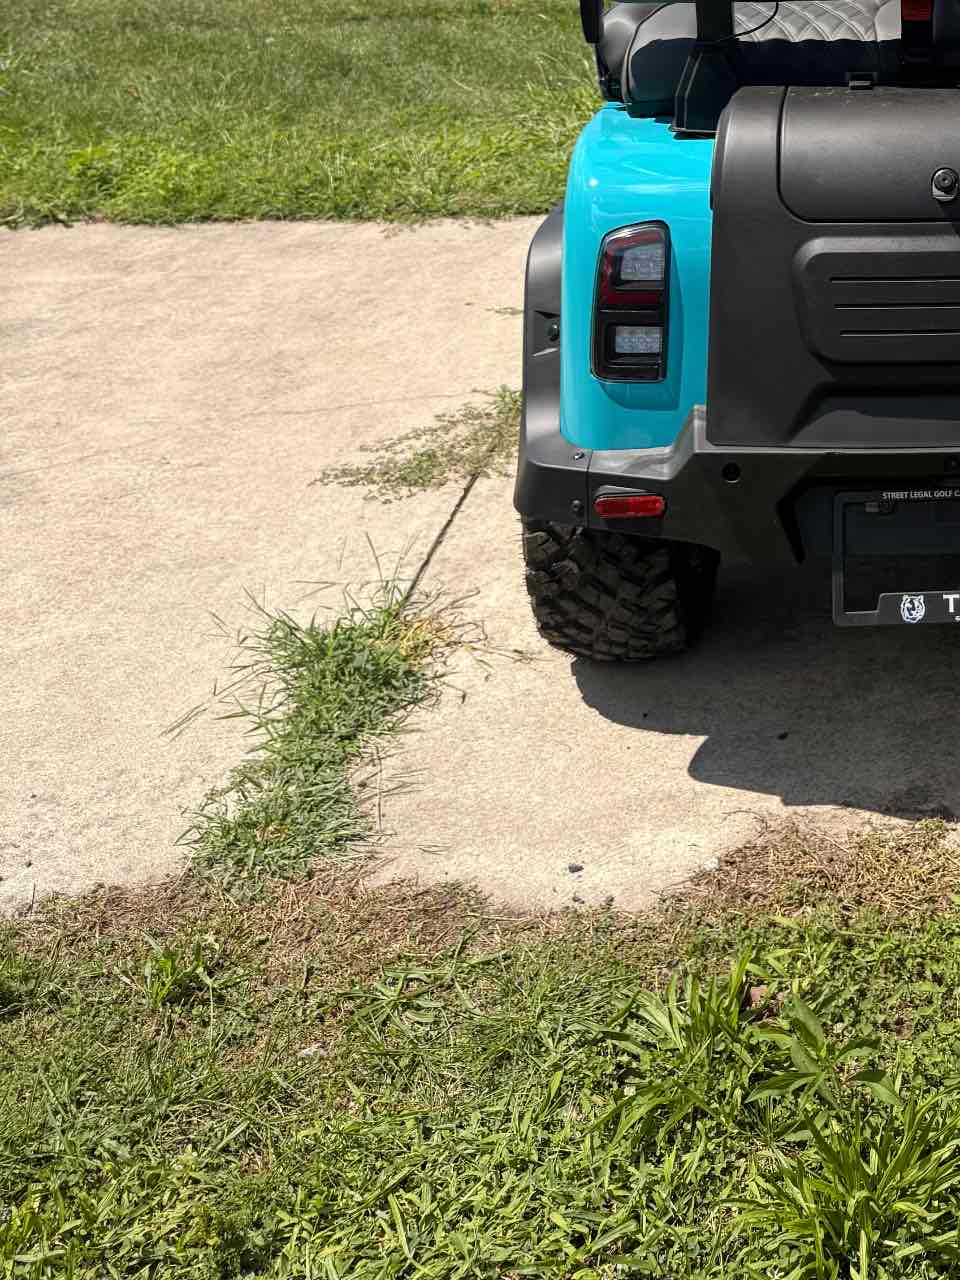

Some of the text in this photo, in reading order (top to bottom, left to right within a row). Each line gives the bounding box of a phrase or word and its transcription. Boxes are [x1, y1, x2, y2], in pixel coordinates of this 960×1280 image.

[882, 491, 908, 500] STREET
[910, 490, 932, 499] LEGAL
[934, 490, 953, 498] GOLF
